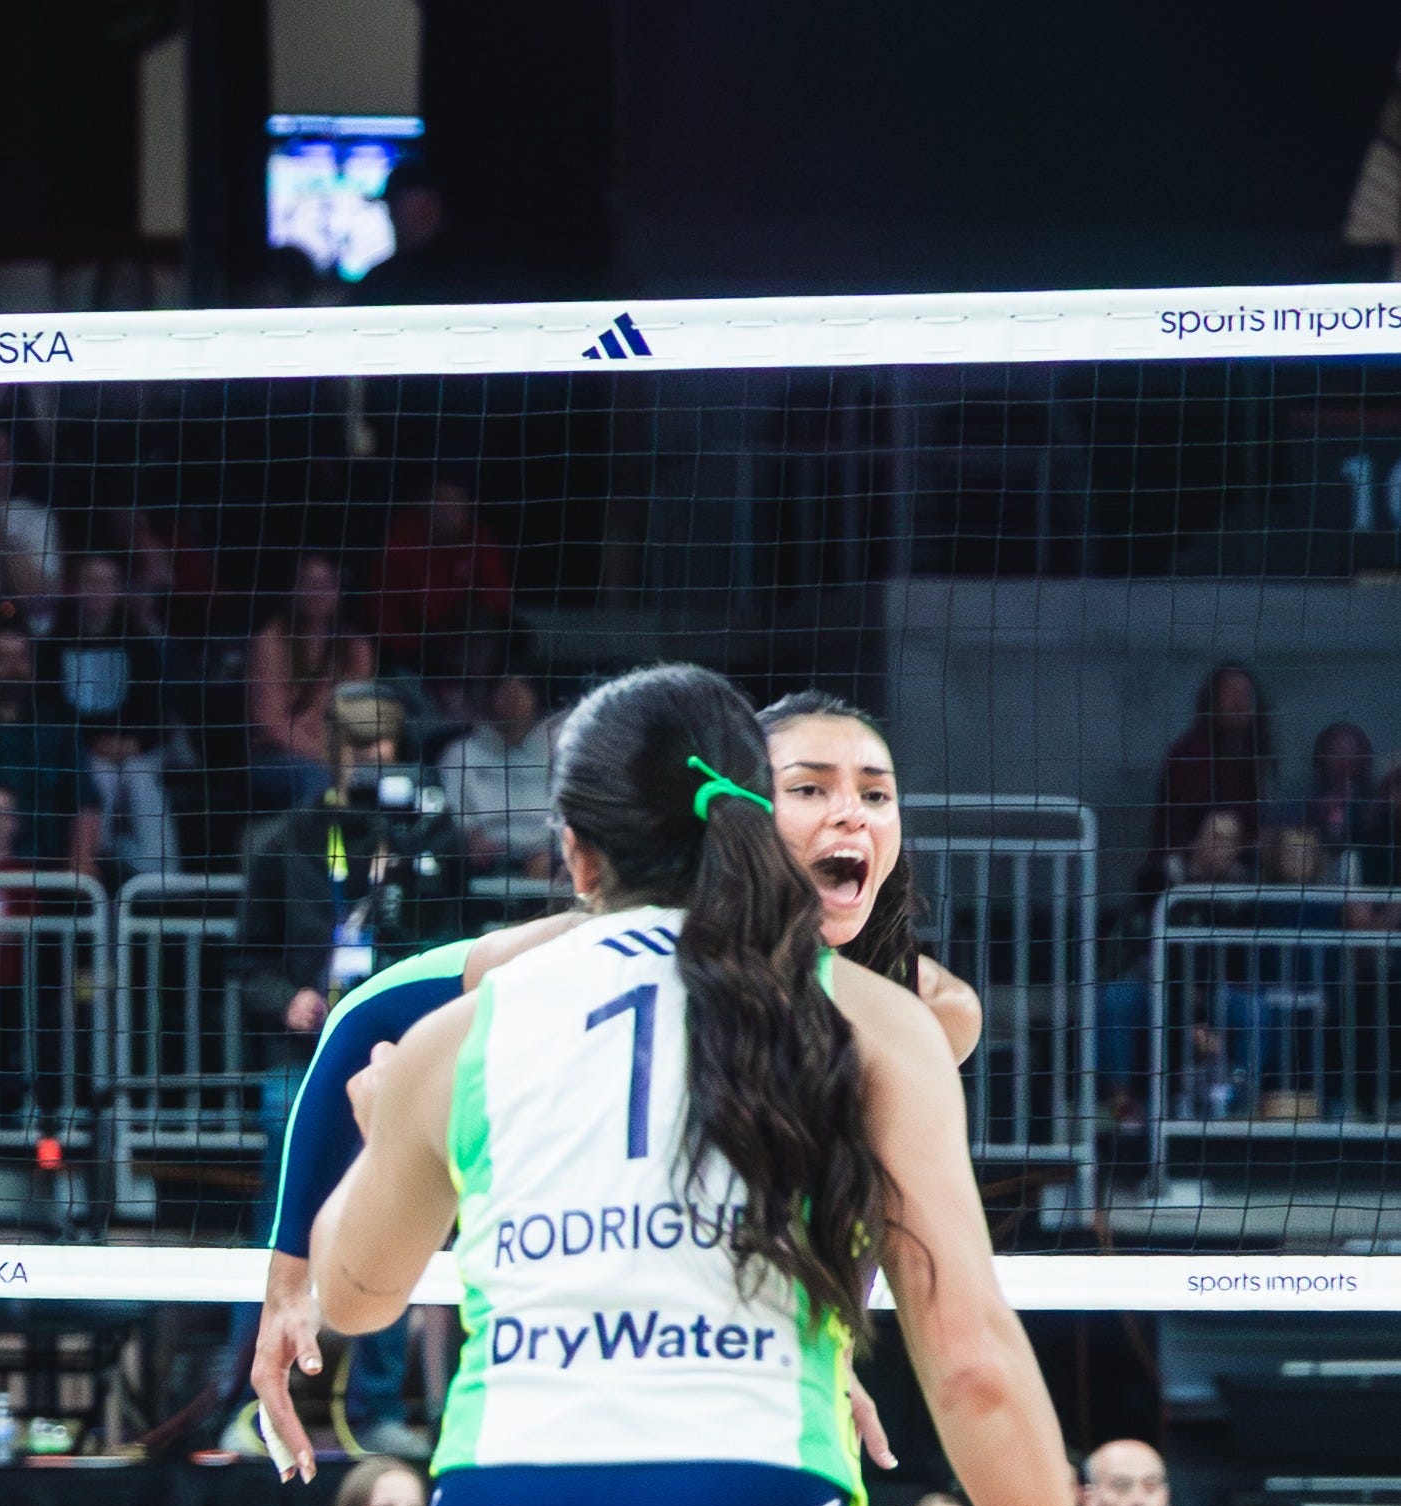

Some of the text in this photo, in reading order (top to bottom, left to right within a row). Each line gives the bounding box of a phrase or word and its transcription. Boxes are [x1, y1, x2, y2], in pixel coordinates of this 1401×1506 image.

[1160, 305, 1265, 340] sports
[585, 983, 658, 1159] 1
[1187, 1273, 1358, 1296] sports imports
